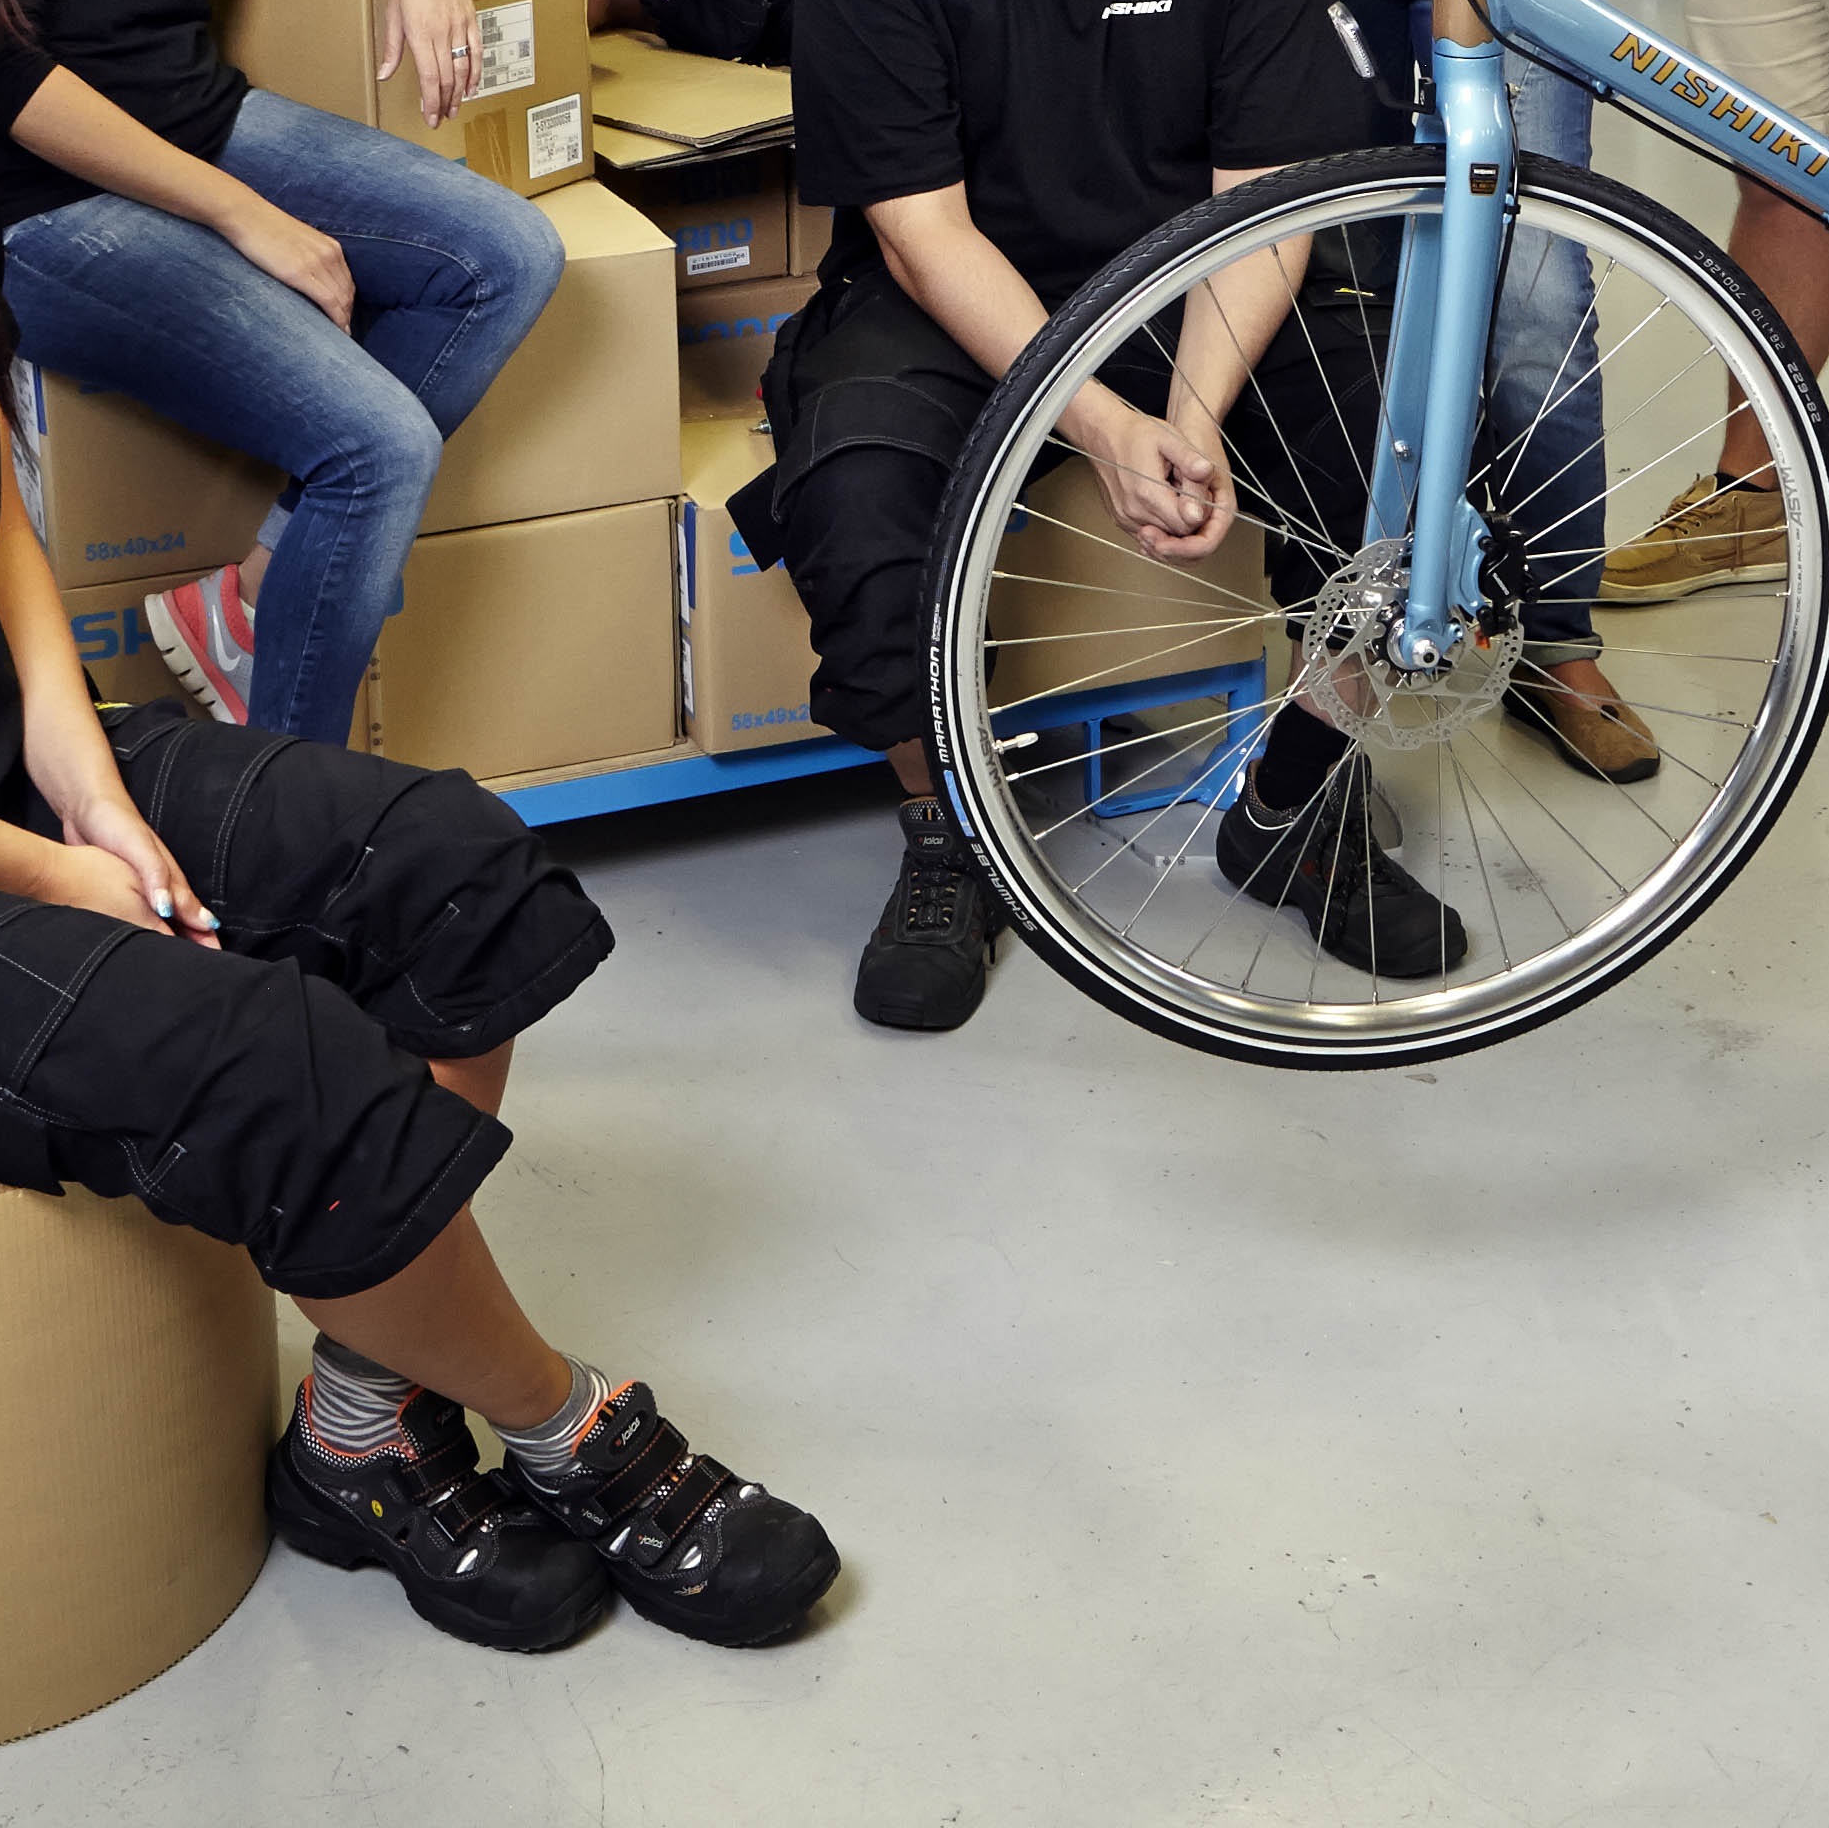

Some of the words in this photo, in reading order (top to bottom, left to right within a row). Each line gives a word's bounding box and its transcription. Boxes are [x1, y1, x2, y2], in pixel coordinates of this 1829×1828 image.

[1786, 361, 1821, 423] 28-622
[929, 646, 950, 764] MARATHON
[971, 842, 1038, 933] SCHWALBE
[620, 1416, 642, 1447] jalas
[639, 1534, 664, 1550] jalas
